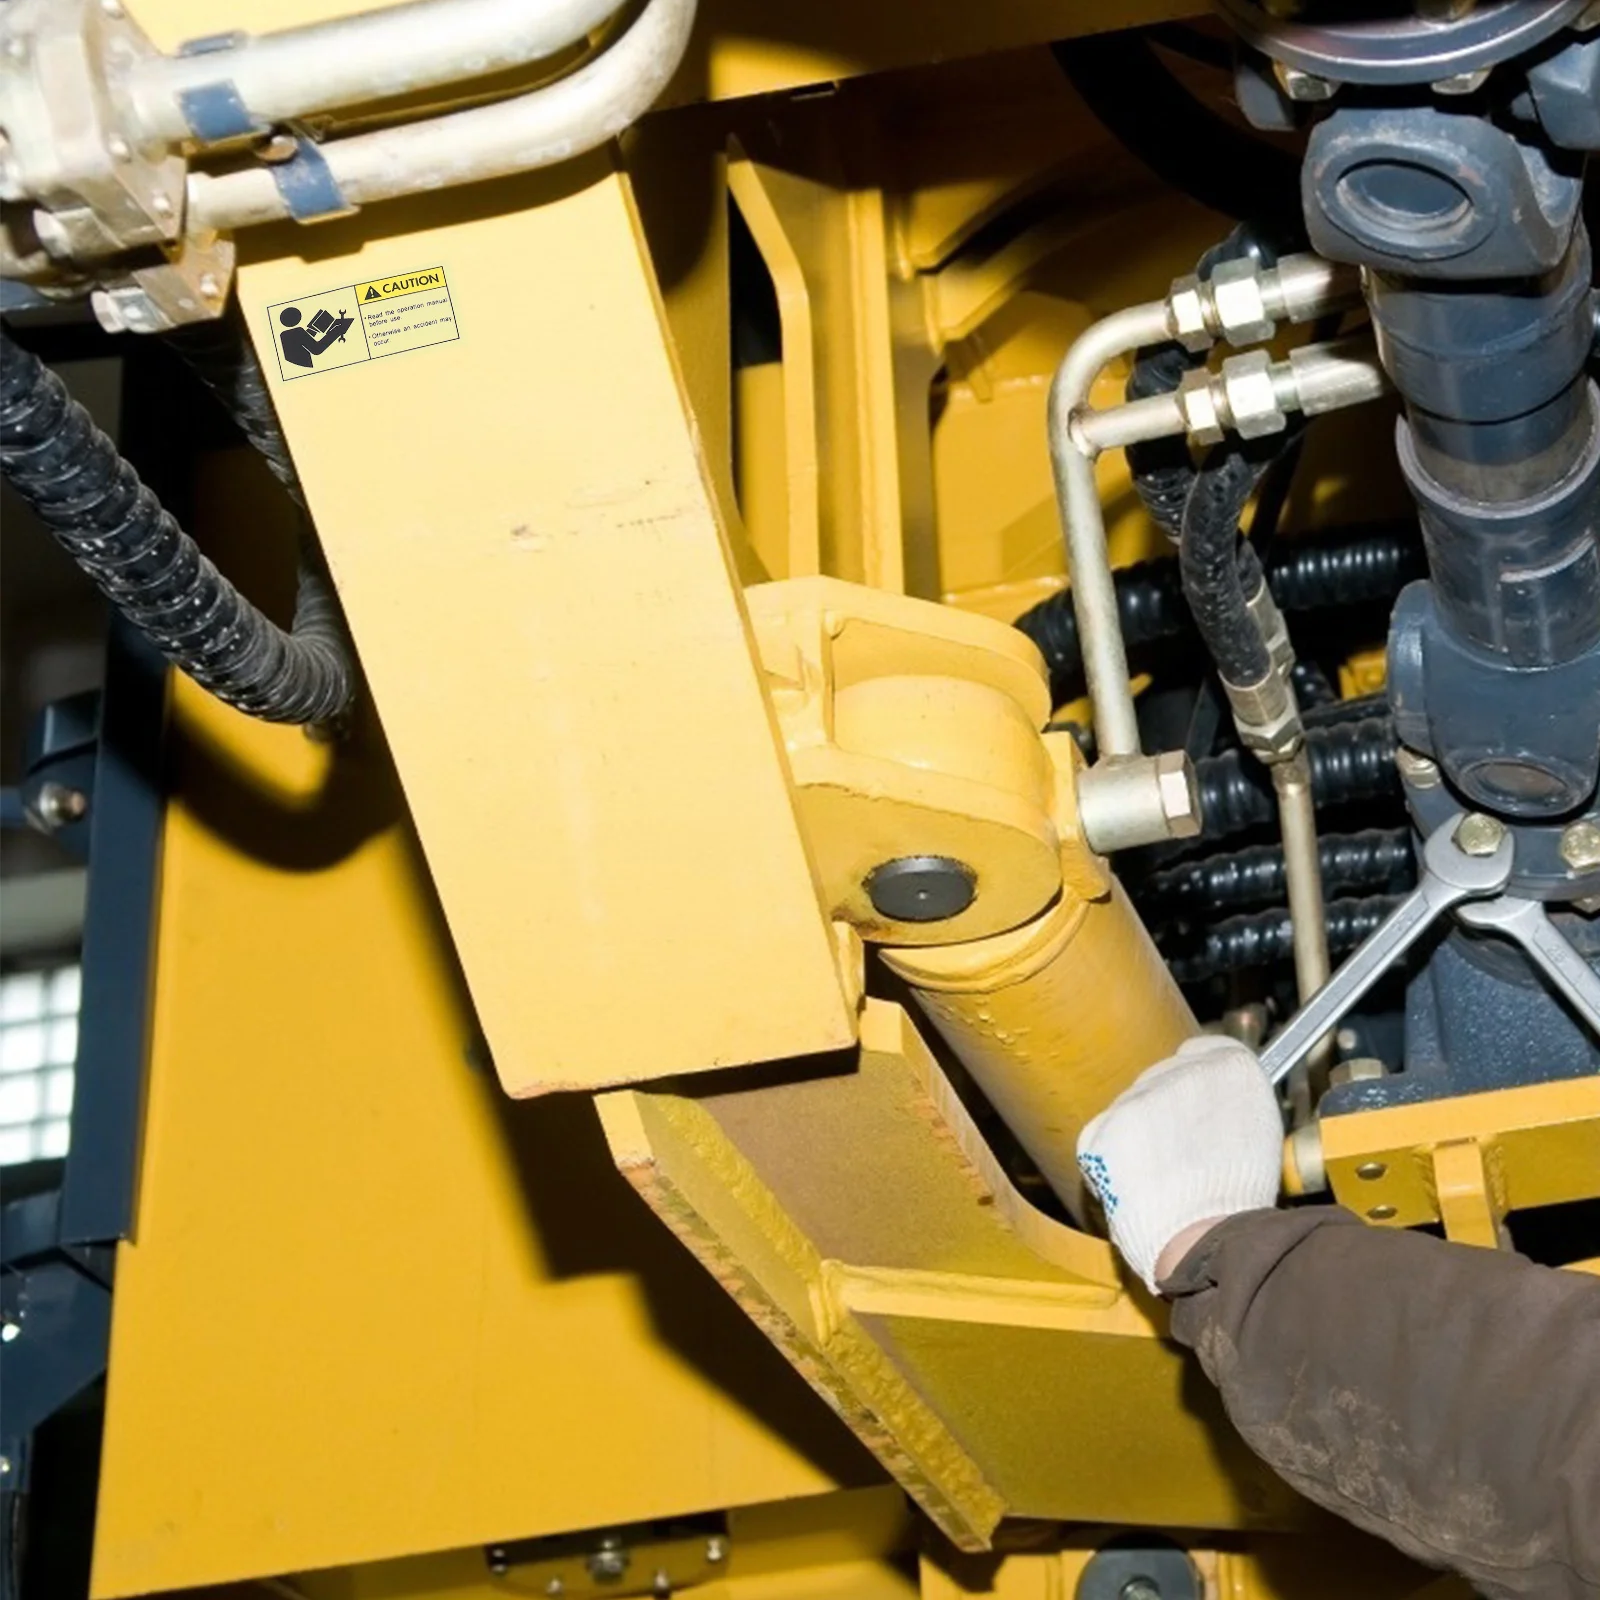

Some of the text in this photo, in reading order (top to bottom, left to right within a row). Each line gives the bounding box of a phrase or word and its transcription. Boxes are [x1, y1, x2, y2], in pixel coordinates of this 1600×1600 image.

[382, 273, 440, 294] CAUTION
[385, 309, 395, 317] the
[397, 302, 425, 314] operation
[426, 297, 448, 307] manual
[368, 318, 388, 328] before
[371, 328, 402, 340] Otherwise
[413, 318, 438, 330] accident
